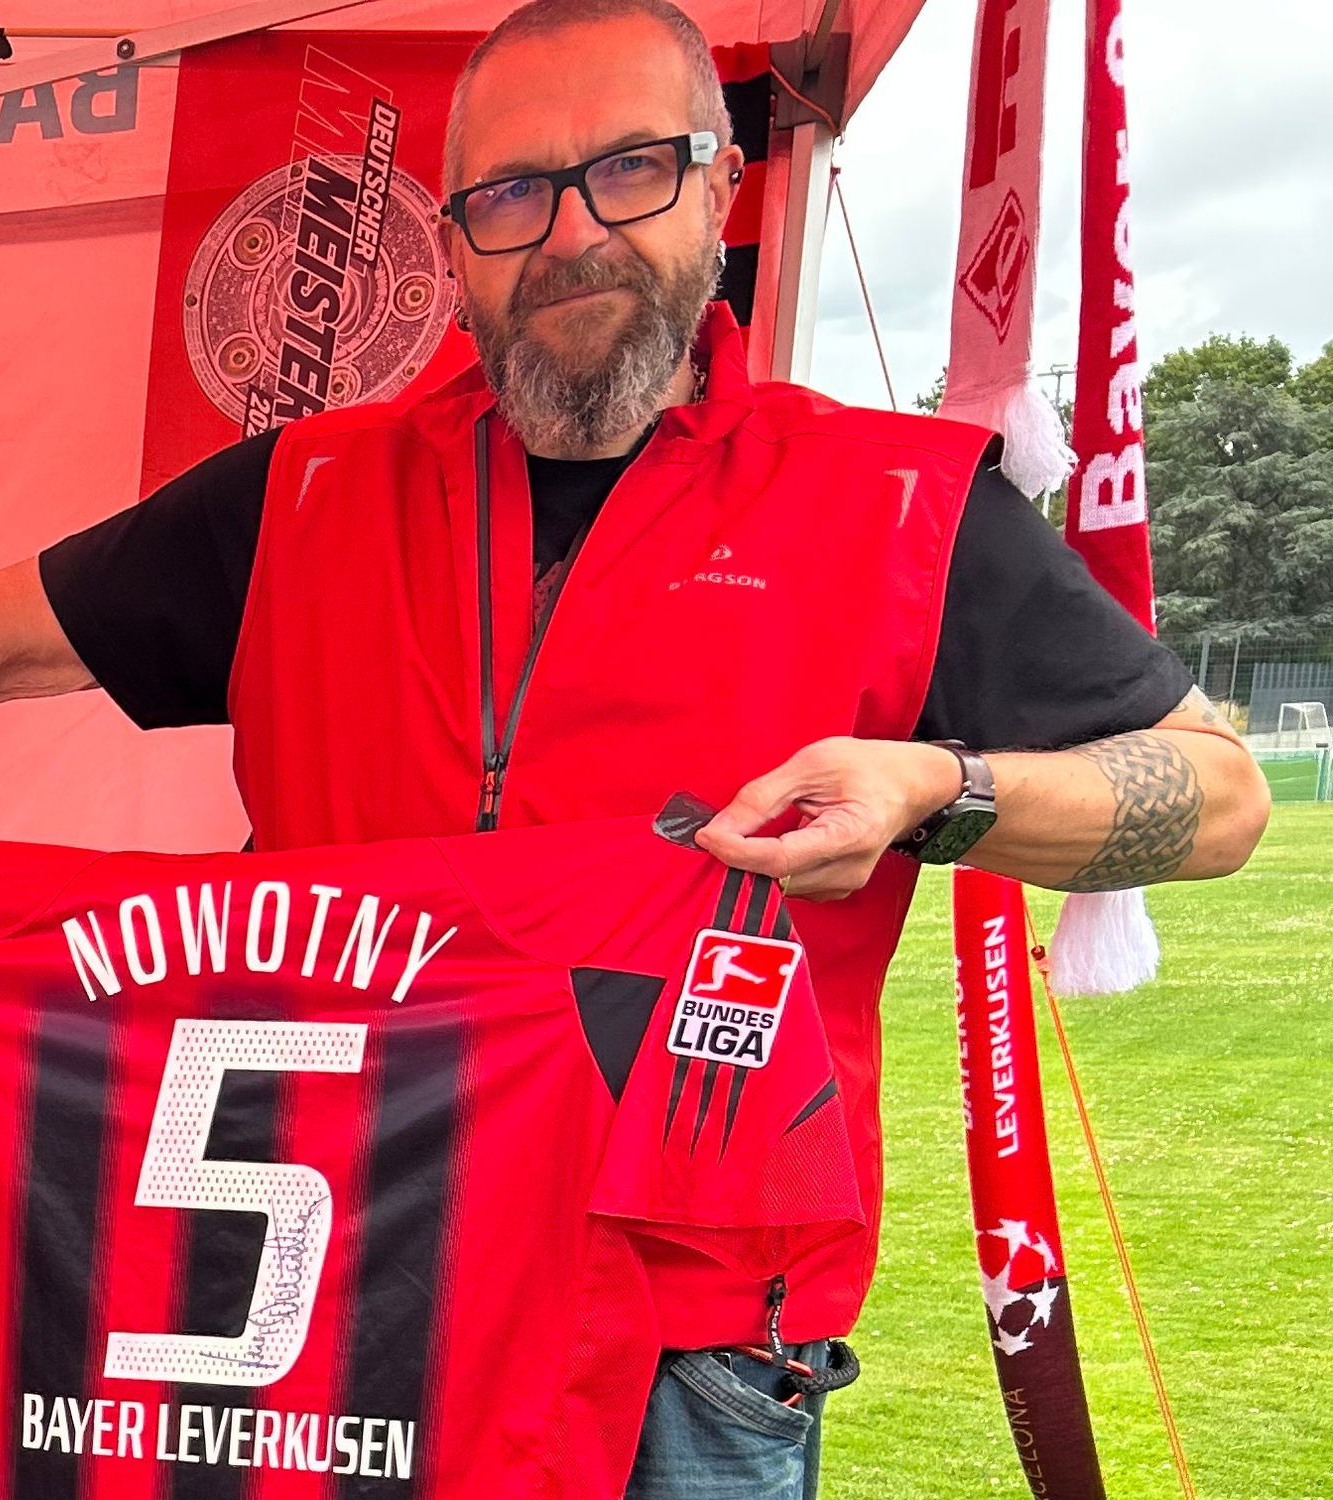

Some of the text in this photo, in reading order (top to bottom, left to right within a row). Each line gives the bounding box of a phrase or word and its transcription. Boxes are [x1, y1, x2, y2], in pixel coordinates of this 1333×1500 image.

[352, 102, 397, 264] DEUTSCHER
[60, 879, 459, 1003] NOWOTNY
[673, 1016, 766, 1064] LIGA
[681, 998, 775, 1032] BUNDES
[982, 914, 1019, 1159] LEVERKUSEN
[103, 1018, 370, 1388] 5
[21, 1391, 416, 1482] BAYER LEVERKUSEN
